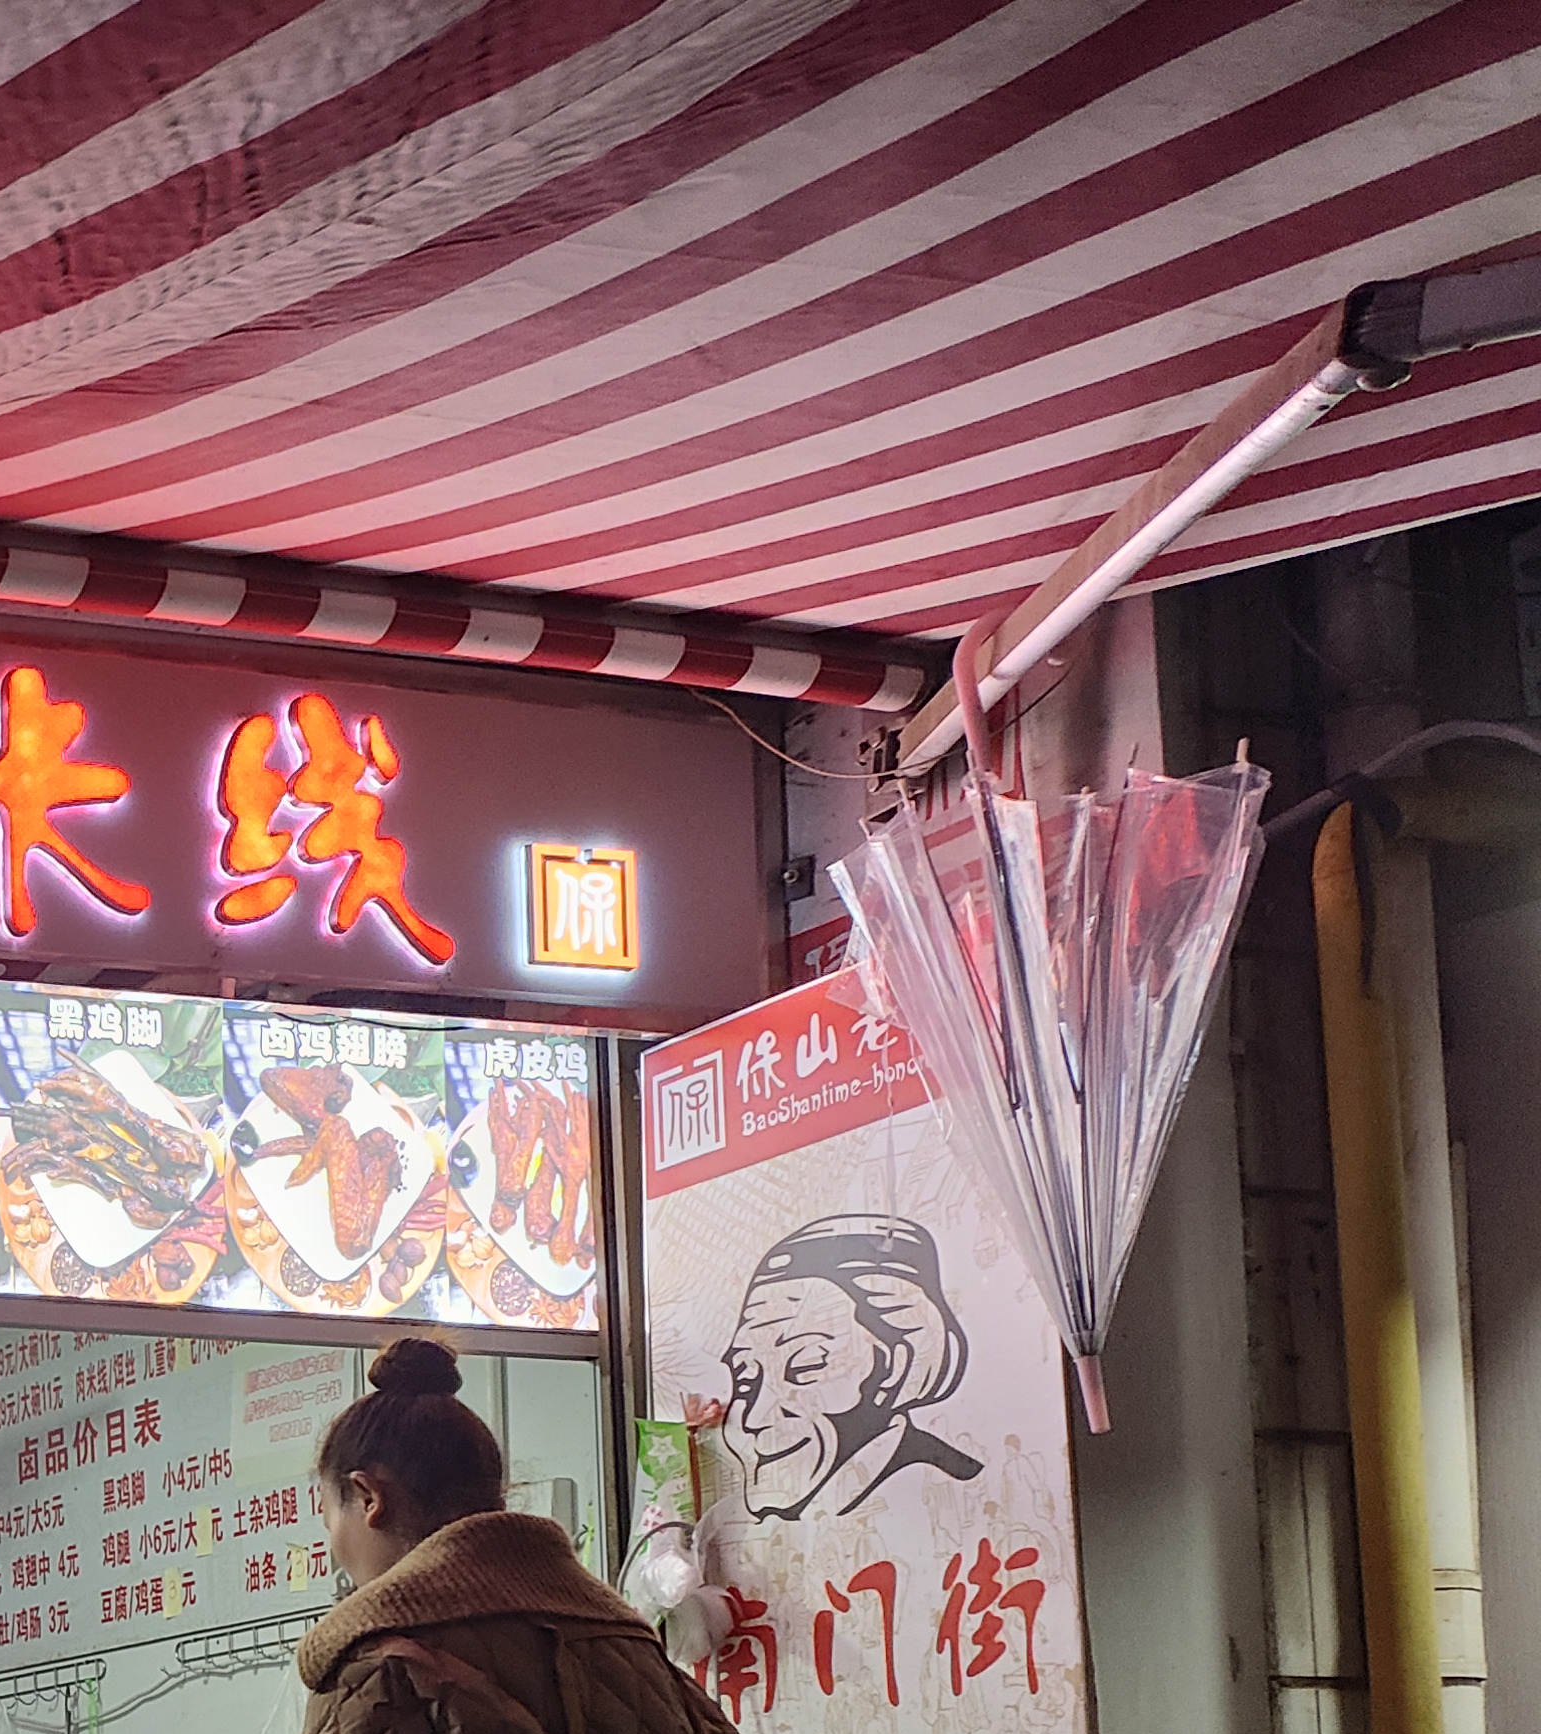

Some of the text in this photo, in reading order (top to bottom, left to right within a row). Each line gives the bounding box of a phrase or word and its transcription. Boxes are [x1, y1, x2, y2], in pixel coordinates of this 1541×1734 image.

[49, 998, 162, 1048] 黑鸡脚
[260, 1019, 407, 1069] 卤鸡翅膀
[484, 1038, 588, 1083] 虎皮鸡
[18, 1397, 163, 1485] 卤品价目表
[103, 1470, 146, 1514] 黑鸡脚
[57, 1544, 80, 1579] 4元
[102, 1529, 131, 1568] 鸡腿
[138, 1506, 224, 1560] 小6元/大元
[48, 1600, 70, 1635] 3元
[244, 1551, 277, 1593] 油条
